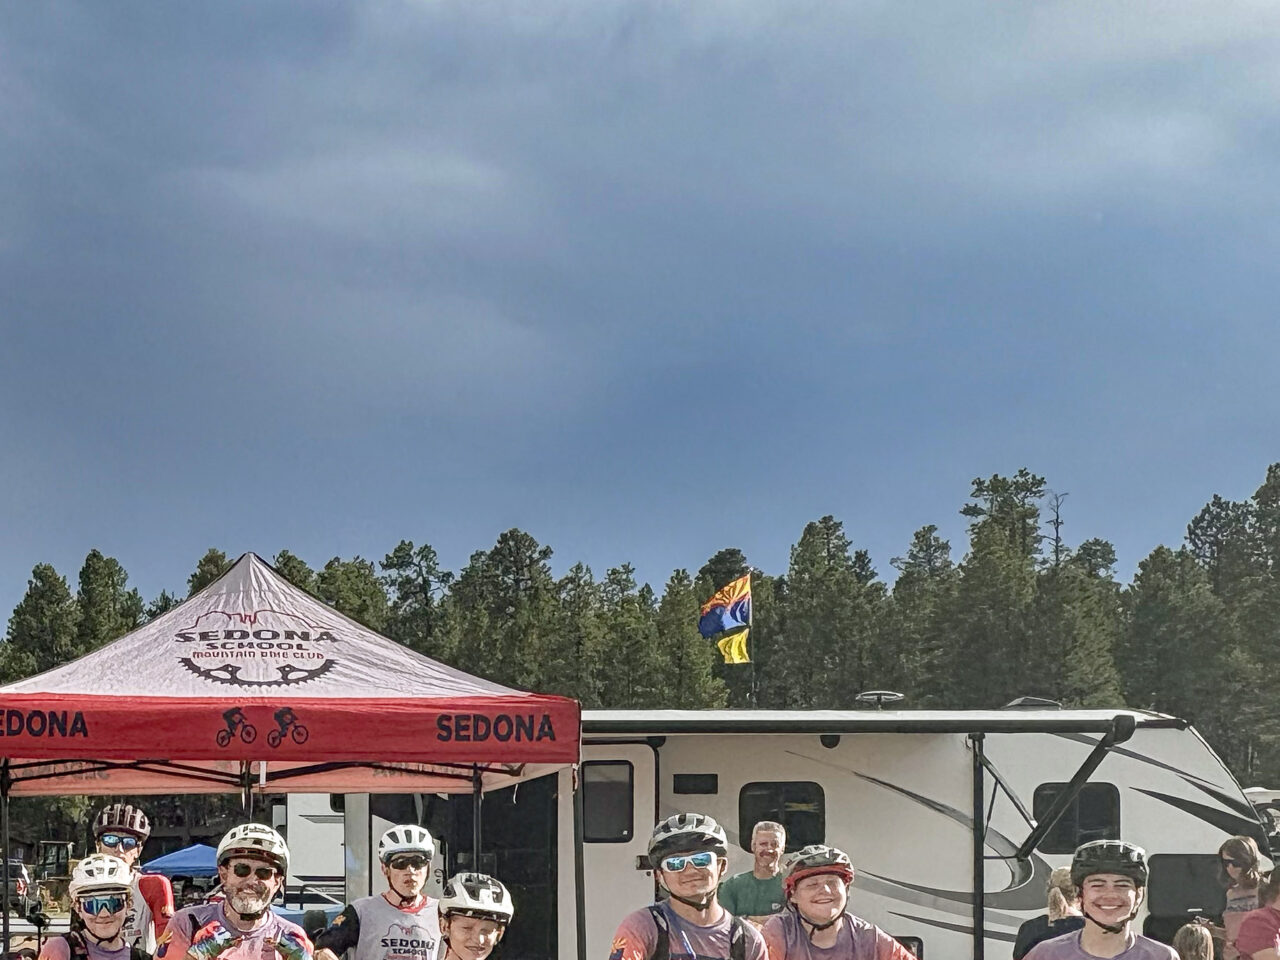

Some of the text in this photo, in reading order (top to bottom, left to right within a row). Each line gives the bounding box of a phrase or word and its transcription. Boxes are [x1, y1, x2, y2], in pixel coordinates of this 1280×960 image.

[175, 629, 340, 643] SEDONA
[206, 642, 310, 651] SCHOOL
[192, 650, 256, 659] MOUNTAIN
[293, 652, 325, 660] CLUB
[436, 714, 556, 742] SEDONA
